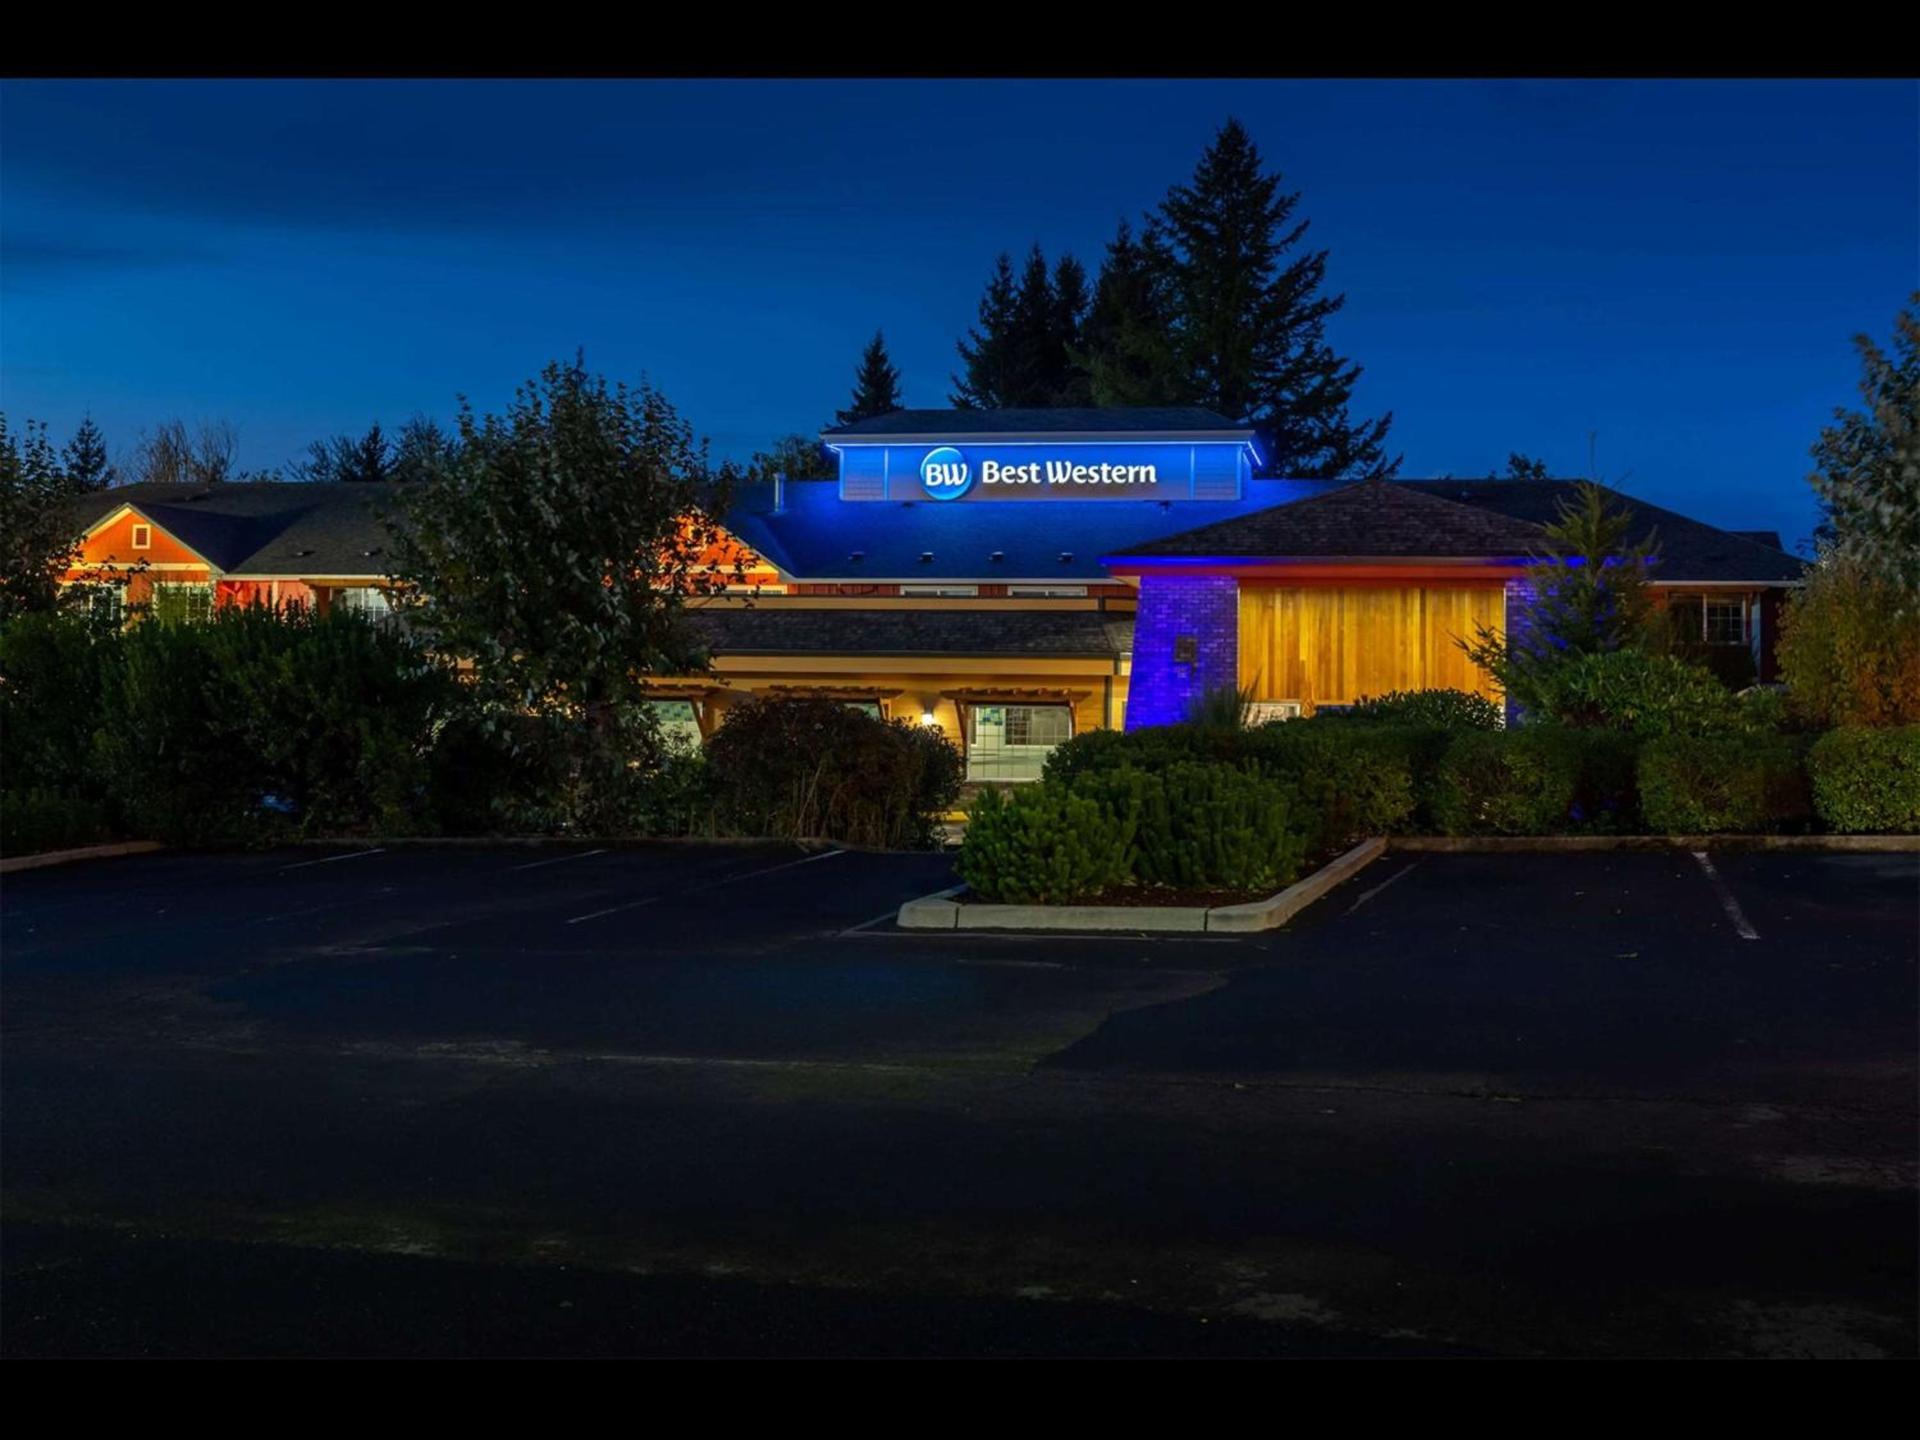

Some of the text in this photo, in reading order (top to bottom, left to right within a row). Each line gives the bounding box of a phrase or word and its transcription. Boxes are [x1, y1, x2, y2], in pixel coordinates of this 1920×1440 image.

[925, 463, 968, 486] BW
[982, 460, 1157, 484] Best Western
